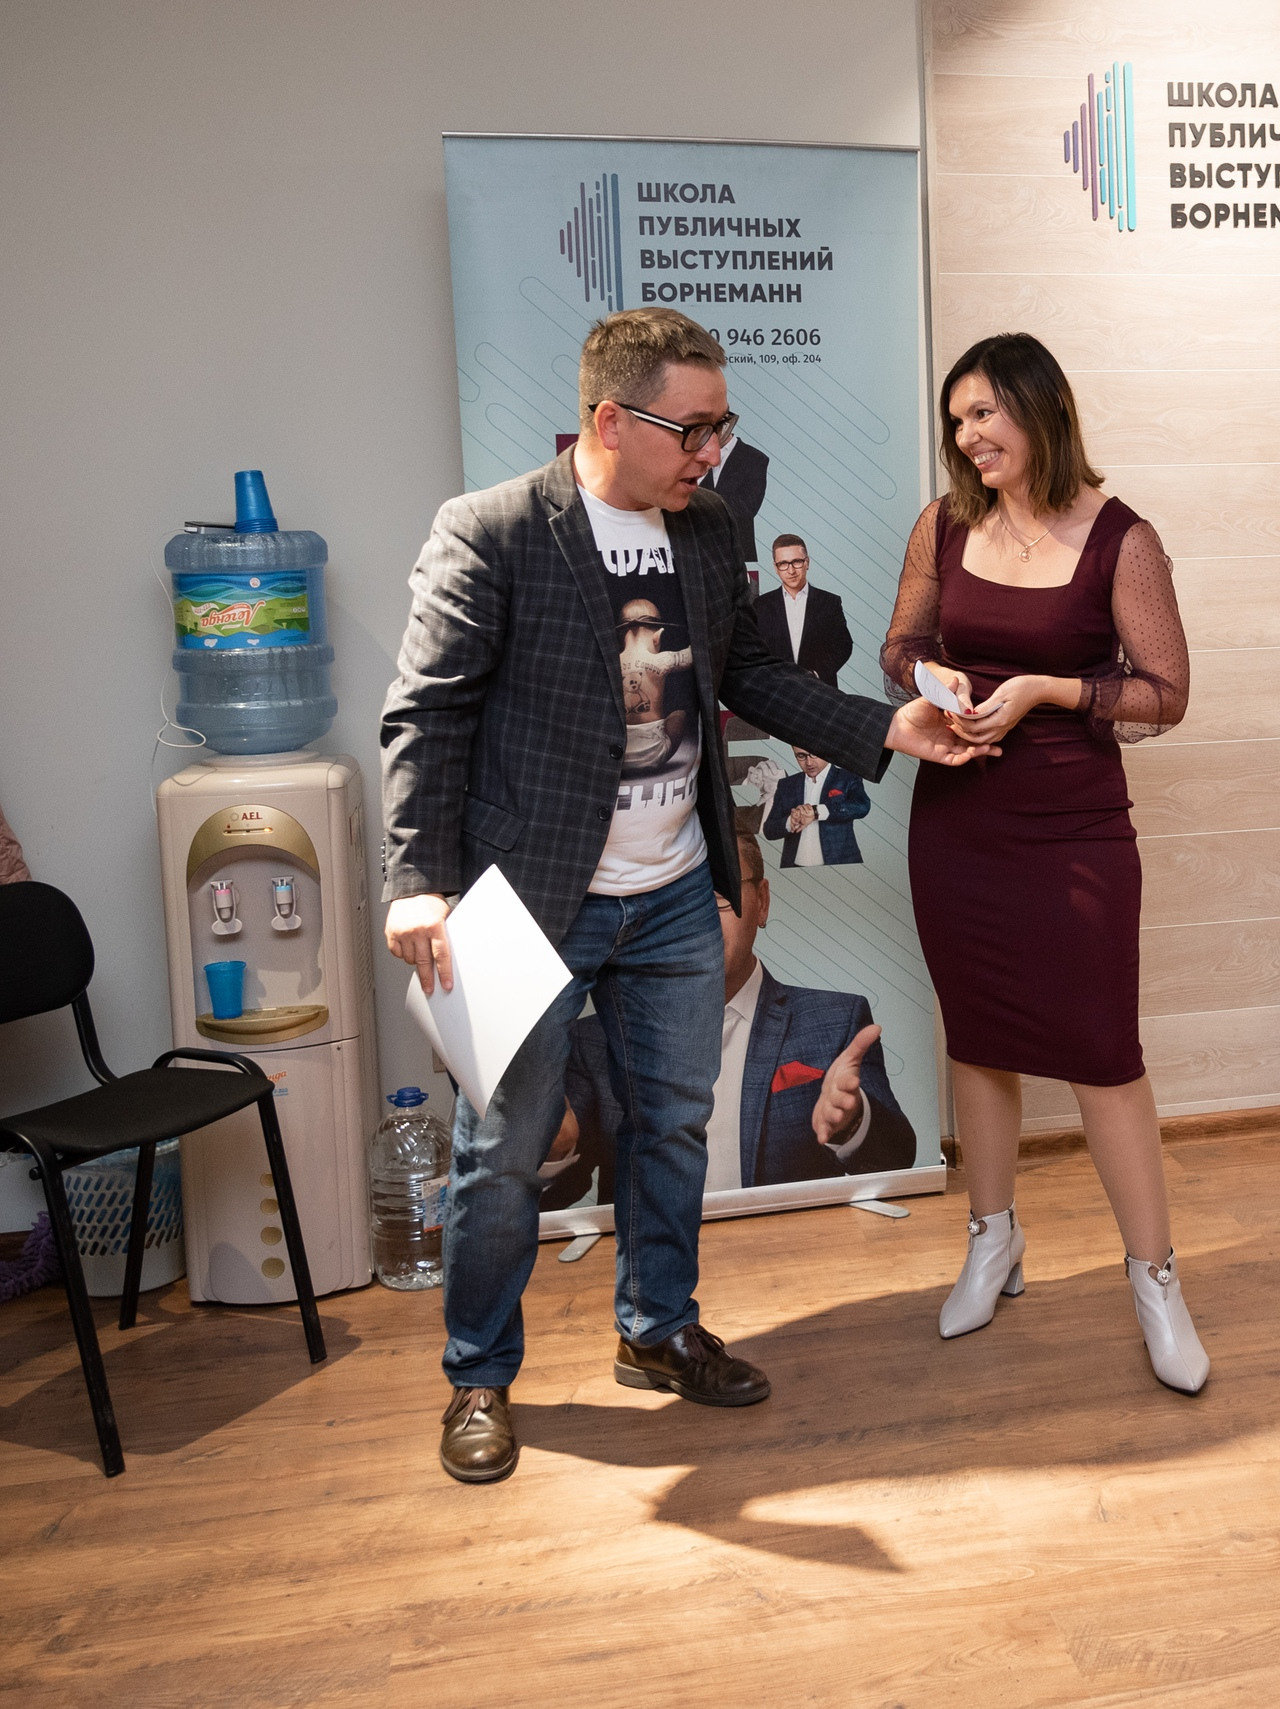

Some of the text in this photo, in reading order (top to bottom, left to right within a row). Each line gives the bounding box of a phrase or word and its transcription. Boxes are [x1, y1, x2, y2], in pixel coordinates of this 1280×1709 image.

[1166, 81, 1279, 109] ШКОЛА
[637, 181, 736, 205] ШКОЛА
[638, 216, 802, 239] ПУБЛИЧНЫХ
[640, 246, 833, 271] ВЫСТУПЛЕНИЙ
[641, 282, 802, 303] БОРНЕМАНН
[727, 328, 765, 346] 946
[771, 328, 821, 346] 2606
[759, 354, 780, 365] 109,
[782, 353, 801, 366] оф.
[803, 354, 822, 364] 204
[201, 600, 266, 628] Легенда
